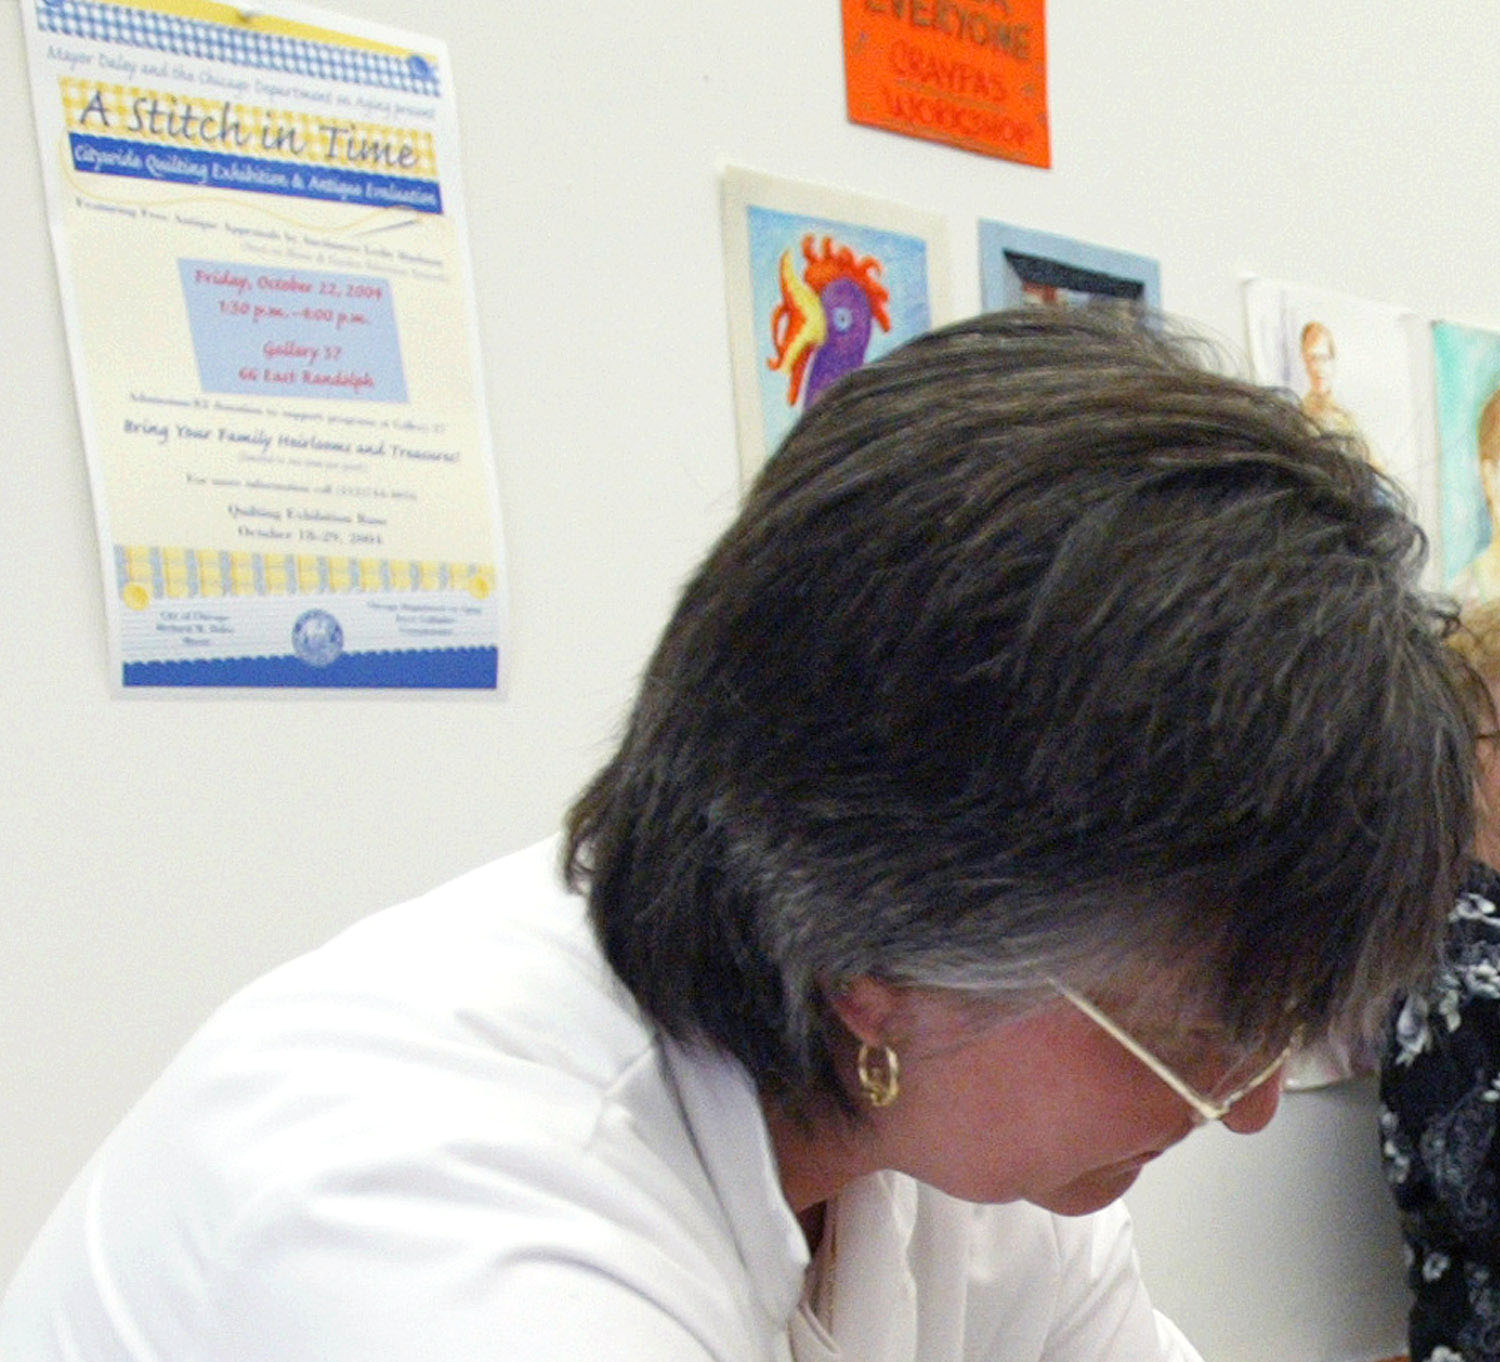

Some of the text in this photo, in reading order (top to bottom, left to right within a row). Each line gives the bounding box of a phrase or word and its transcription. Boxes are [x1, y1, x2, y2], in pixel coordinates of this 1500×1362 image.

[47, 45, 91, 71] Mayor
[99, 52, 136, 80] Daley
[141, 62, 168, 78] and
[78, 89, 420, 168] A Stitch in Time
[74, 143, 143, 171] Citywide
[145, 154, 208, 182] Quilting
[211, 162, 289, 186] Exhibition
[307, 174, 363, 202] Antique
[194, 268, 382, 302] Friday, October 22, 2004
[263, 341, 318, 366] Gallery
[263, 368, 296, 384] East
[302, 370, 376, 395] Randolph
[124, 418, 169, 446] Bring
[176, 424, 212, 441] Your
[218, 427, 272, 452] Family
[277, 434, 350, 453] Heirlooms
[355, 440, 386, 456] and
[227, 503, 282, 521] Quilting
[286, 506, 352, 524] Exhibition
[237, 524, 292, 540] October
